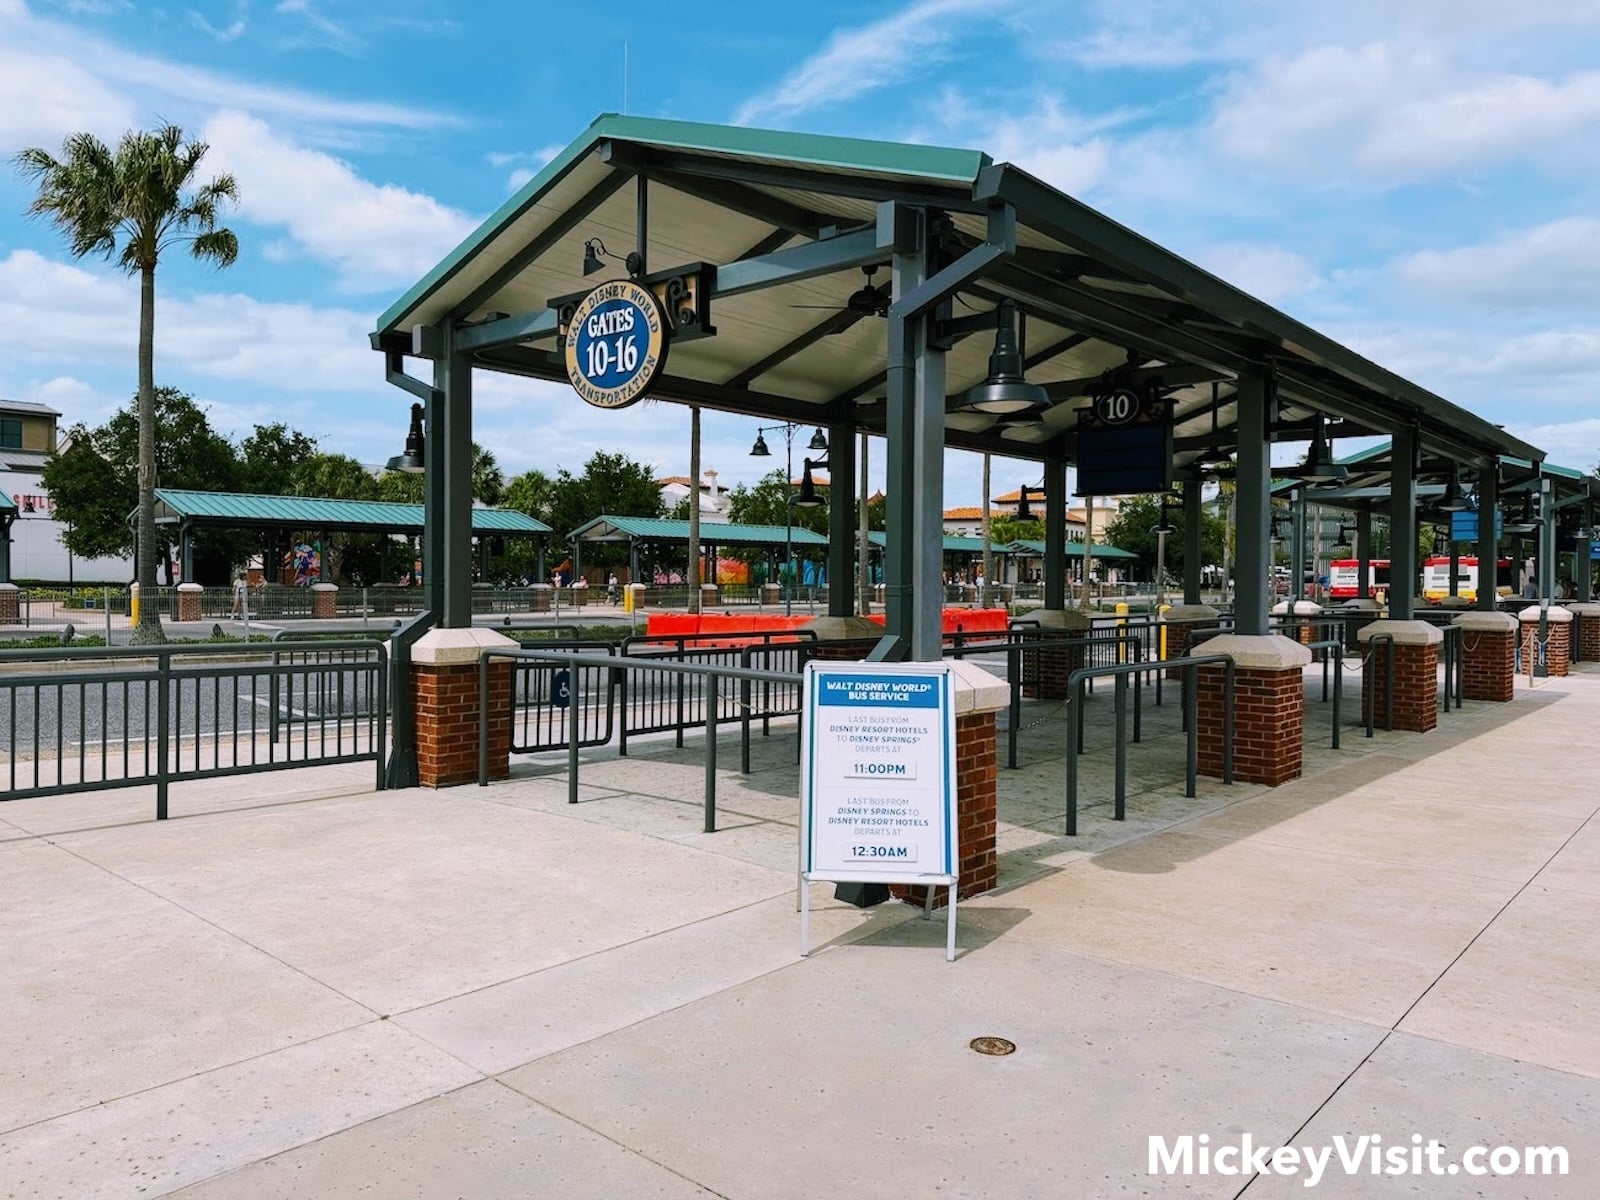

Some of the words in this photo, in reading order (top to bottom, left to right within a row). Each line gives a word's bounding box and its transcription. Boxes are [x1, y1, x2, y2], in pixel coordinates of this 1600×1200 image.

[568, 306, 587, 347] WALT
[588, 285, 627, 308] DISNEY
[630, 288, 659, 333] WORLD
[587, 307, 634, 338] GATES
[586, 335, 638, 378] 10-16
[571, 356, 656, 404] TRANSPORTATION
[1106, 395, 1129, 419] 10
[826, 681, 853, 690] WALT
[854, 682, 890, 692] DISNEY
[848, 691, 868, 700] BUS
[868, 692, 910, 701] SERVICE
[869, 716, 884, 724] BUS
[895, 726, 928, 735] HOTELS
[849, 735, 880, 743] DISNEY
[855, 745, 891, 753] DEPARTS
[854, 763, 906, 775] 11:00PM
[847, 797, 868, 805] LAST
[869, 798, 885, 806] BUS
[885, 798, 909, 806] FROM
[837, 807, 868, 815] DISNEY
[870, 808, 907, 816] SPRINGS
[860, 817, 893, 826] RESORT
[895, 818, 929, 827] HOTELS
[854, 828, 891, 836] DEPARTS
[891, 828, 902, 836] AT
[851, 846, 908, 857] 12:30AM
